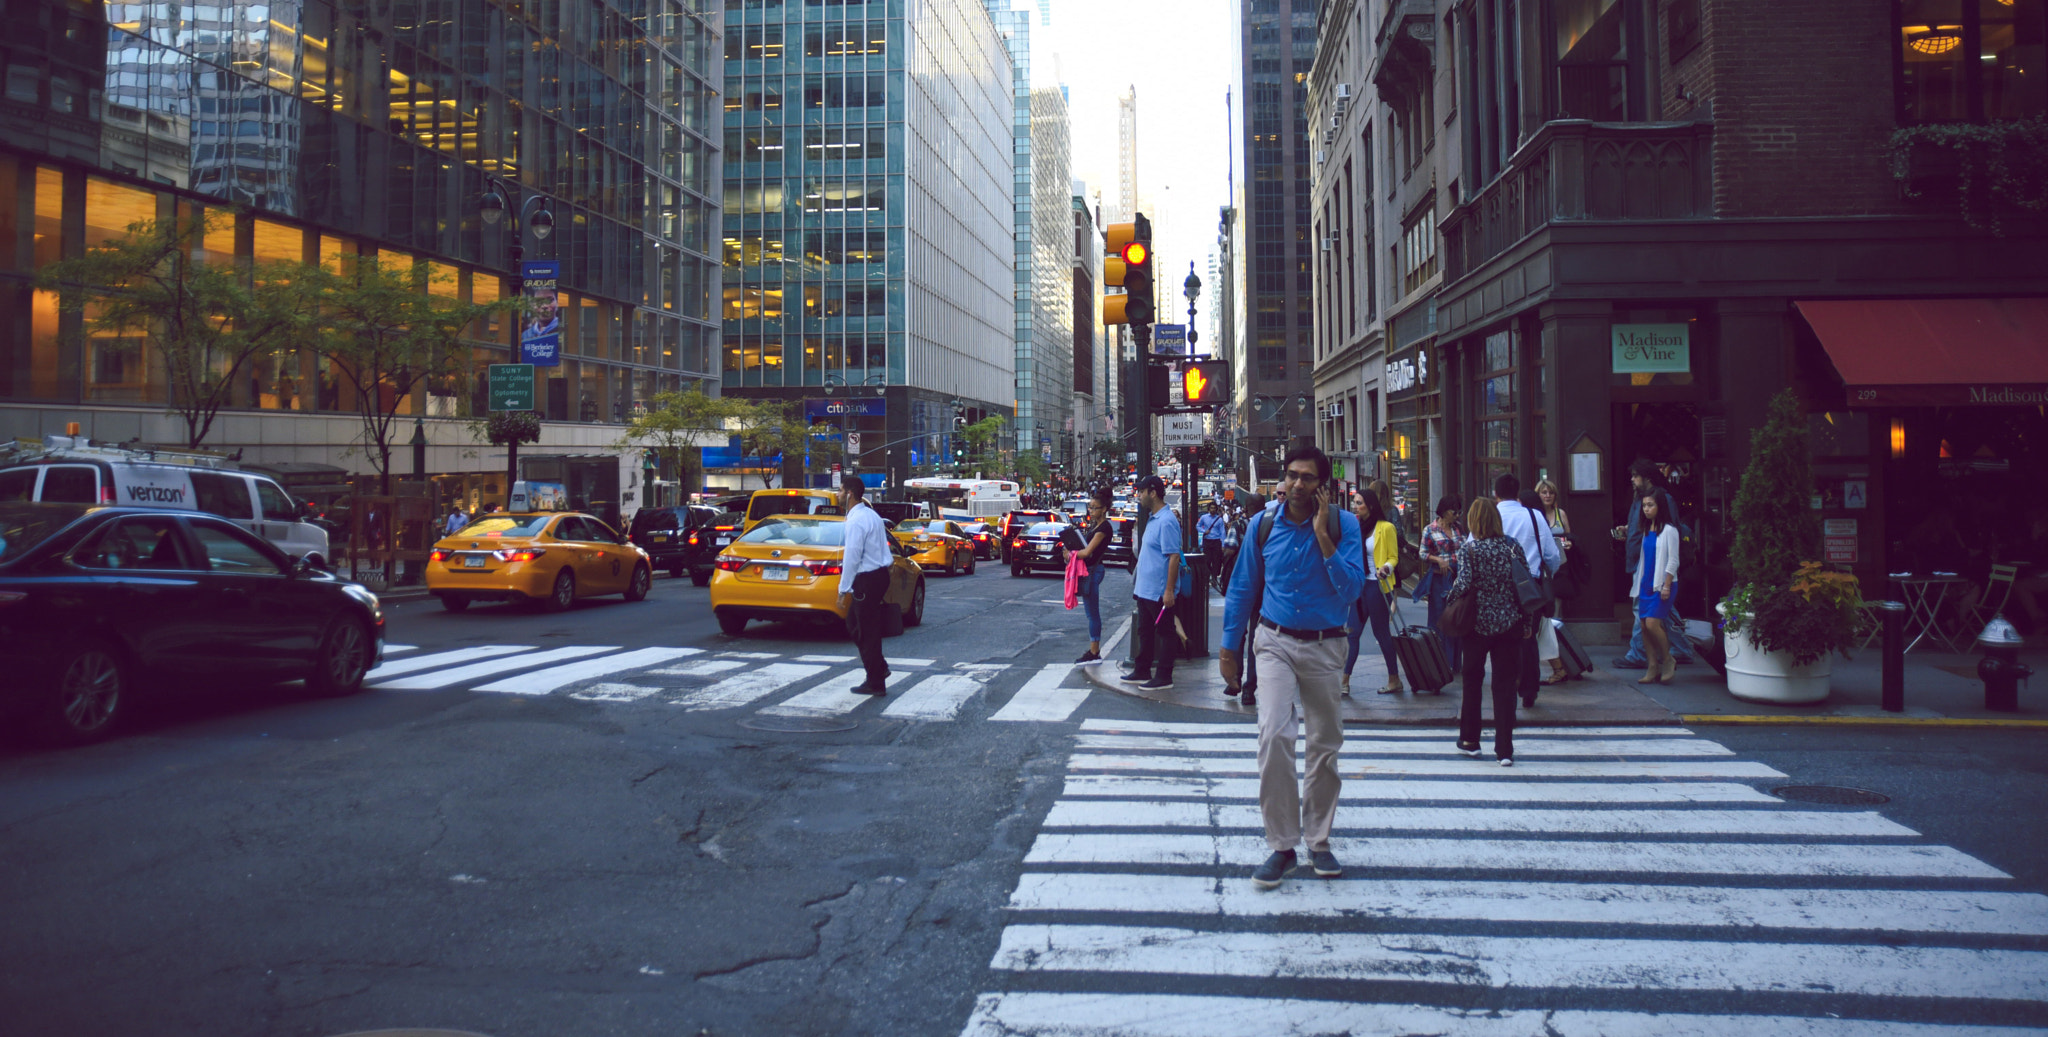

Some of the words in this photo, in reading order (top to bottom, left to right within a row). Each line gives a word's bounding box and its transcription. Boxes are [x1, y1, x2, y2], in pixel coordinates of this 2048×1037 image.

[523, 279, 557, 288] GRADUATE
[1618, 332, 1683, 346] Madison
[530, 343, 555, 352] Berkeley
[531, 349, 554, 358] College
[1641, 346, 1676, 360] Vine
[509, 375, 532, 383] College
[1857, 390, 1877, 400] 299
[1172, 421, 1193, 430] MUST
[1183, 433, 1201, 441] RIGHT
[126, 482, 183, 503] verizon
[1848, 484, 1863, 501] A
